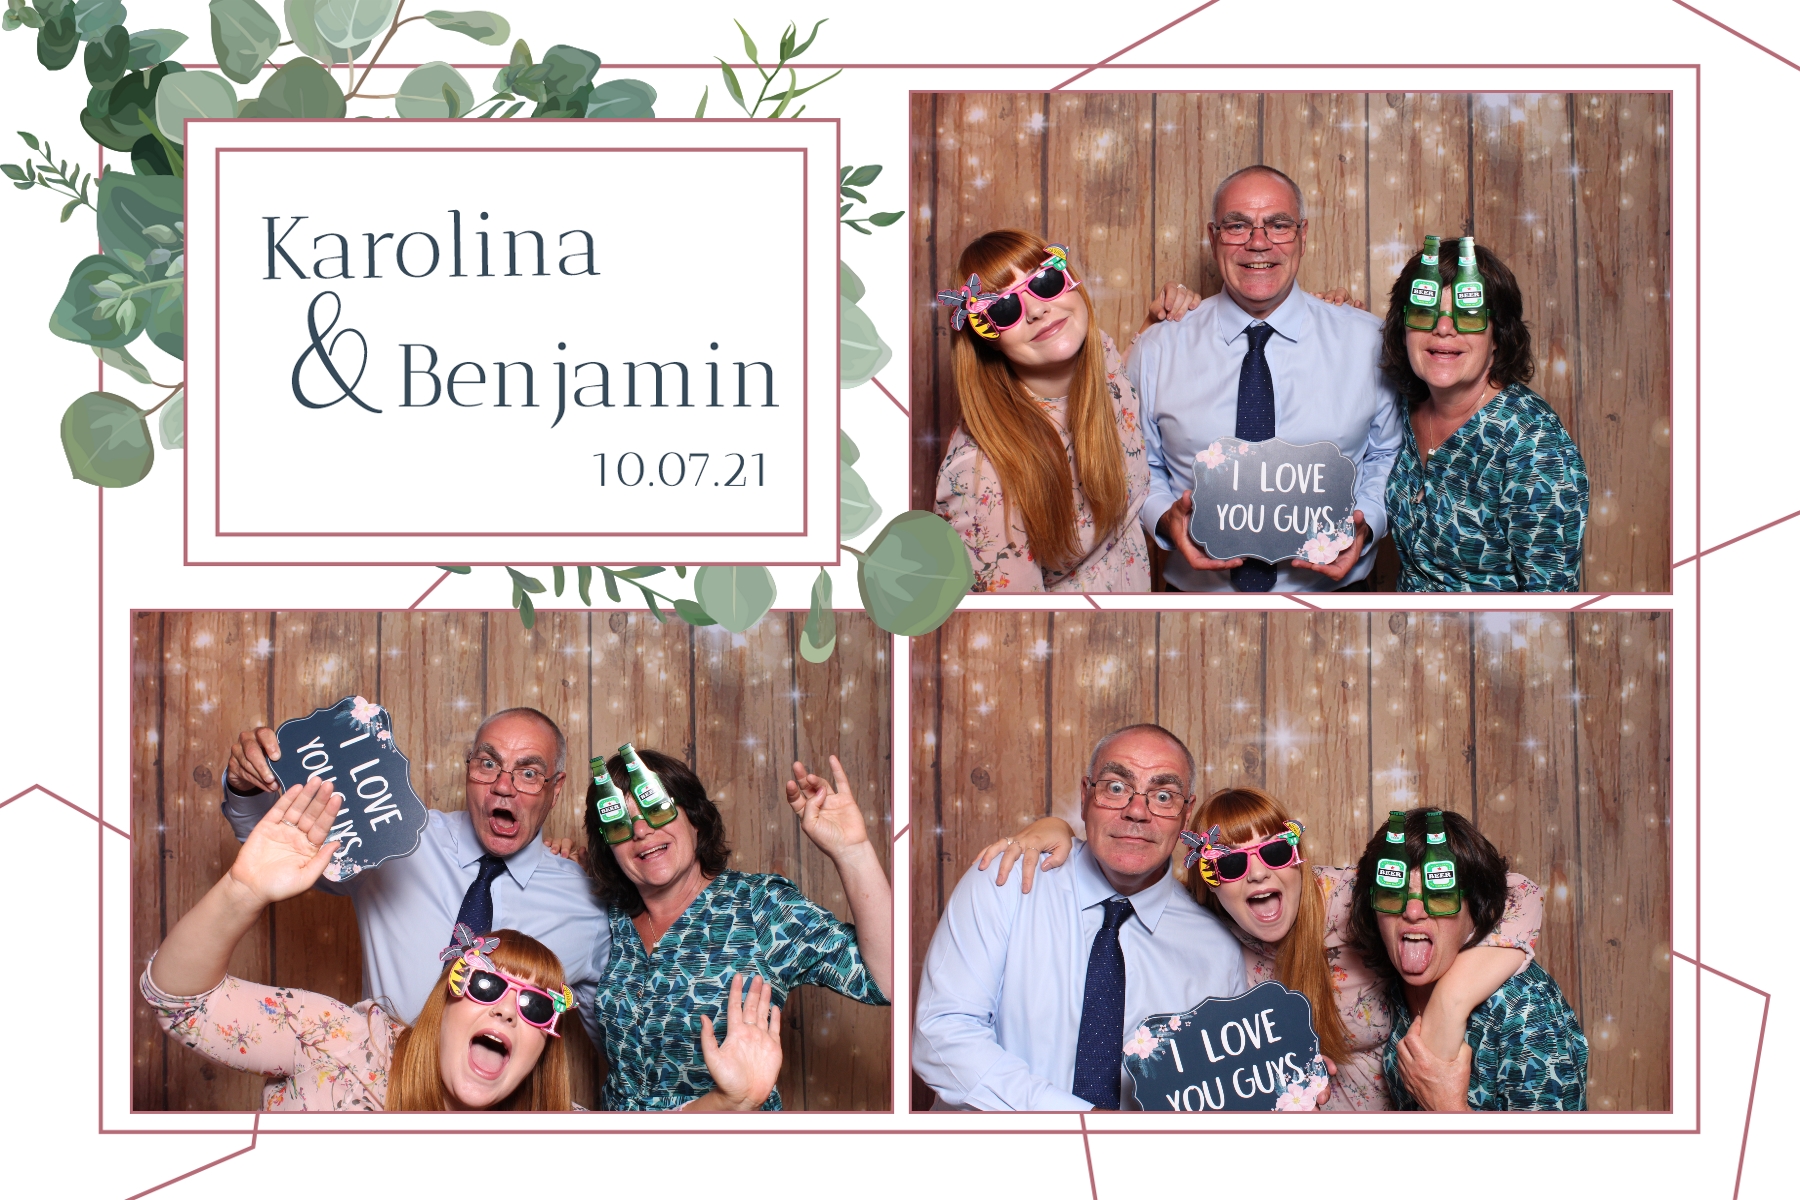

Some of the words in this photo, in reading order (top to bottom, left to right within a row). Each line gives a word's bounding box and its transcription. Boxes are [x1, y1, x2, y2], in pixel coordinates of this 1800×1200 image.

[1413, 288, 1435, 297] BEER
[1458, 291, 1480, 299] BEER
[1232, 460, 1239, 491] I
[1261, 461, 1326, 494] LOVE
[1216, 503, 1265, 533] YOU
[1273, 504, 1335, 535] GUYS
[339, 732, 371, 749] I
[350, 757, 403, 832] LOVE
[1379, 869, 1402, 878] BEER
[1428, 872, 1452, 880] BEER
[1169, 1038, 1184, 1073] I
[1201, 1008, 1282, 1063] LOVE
[1165, 1076, 1225, 1111] YOU
[1232, 1052, 1305, 1099] GUYS
